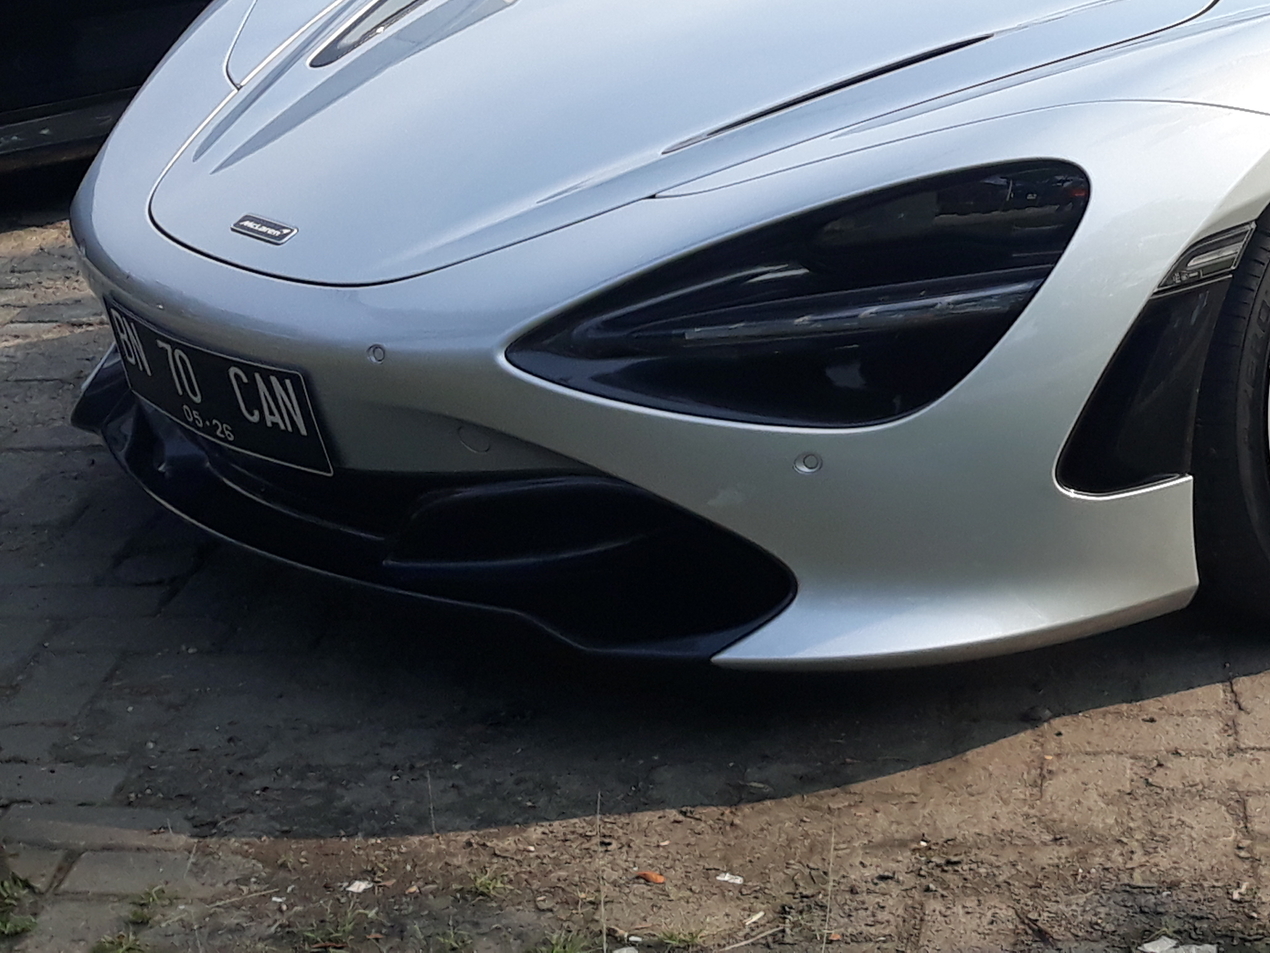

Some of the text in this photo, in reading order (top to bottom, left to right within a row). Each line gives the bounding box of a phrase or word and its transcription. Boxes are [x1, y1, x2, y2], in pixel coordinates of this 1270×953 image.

[239, 220, 282, 237] McLaren
[156, 339, 202, 404] 70
[228, 366, 308, 436] CAN
